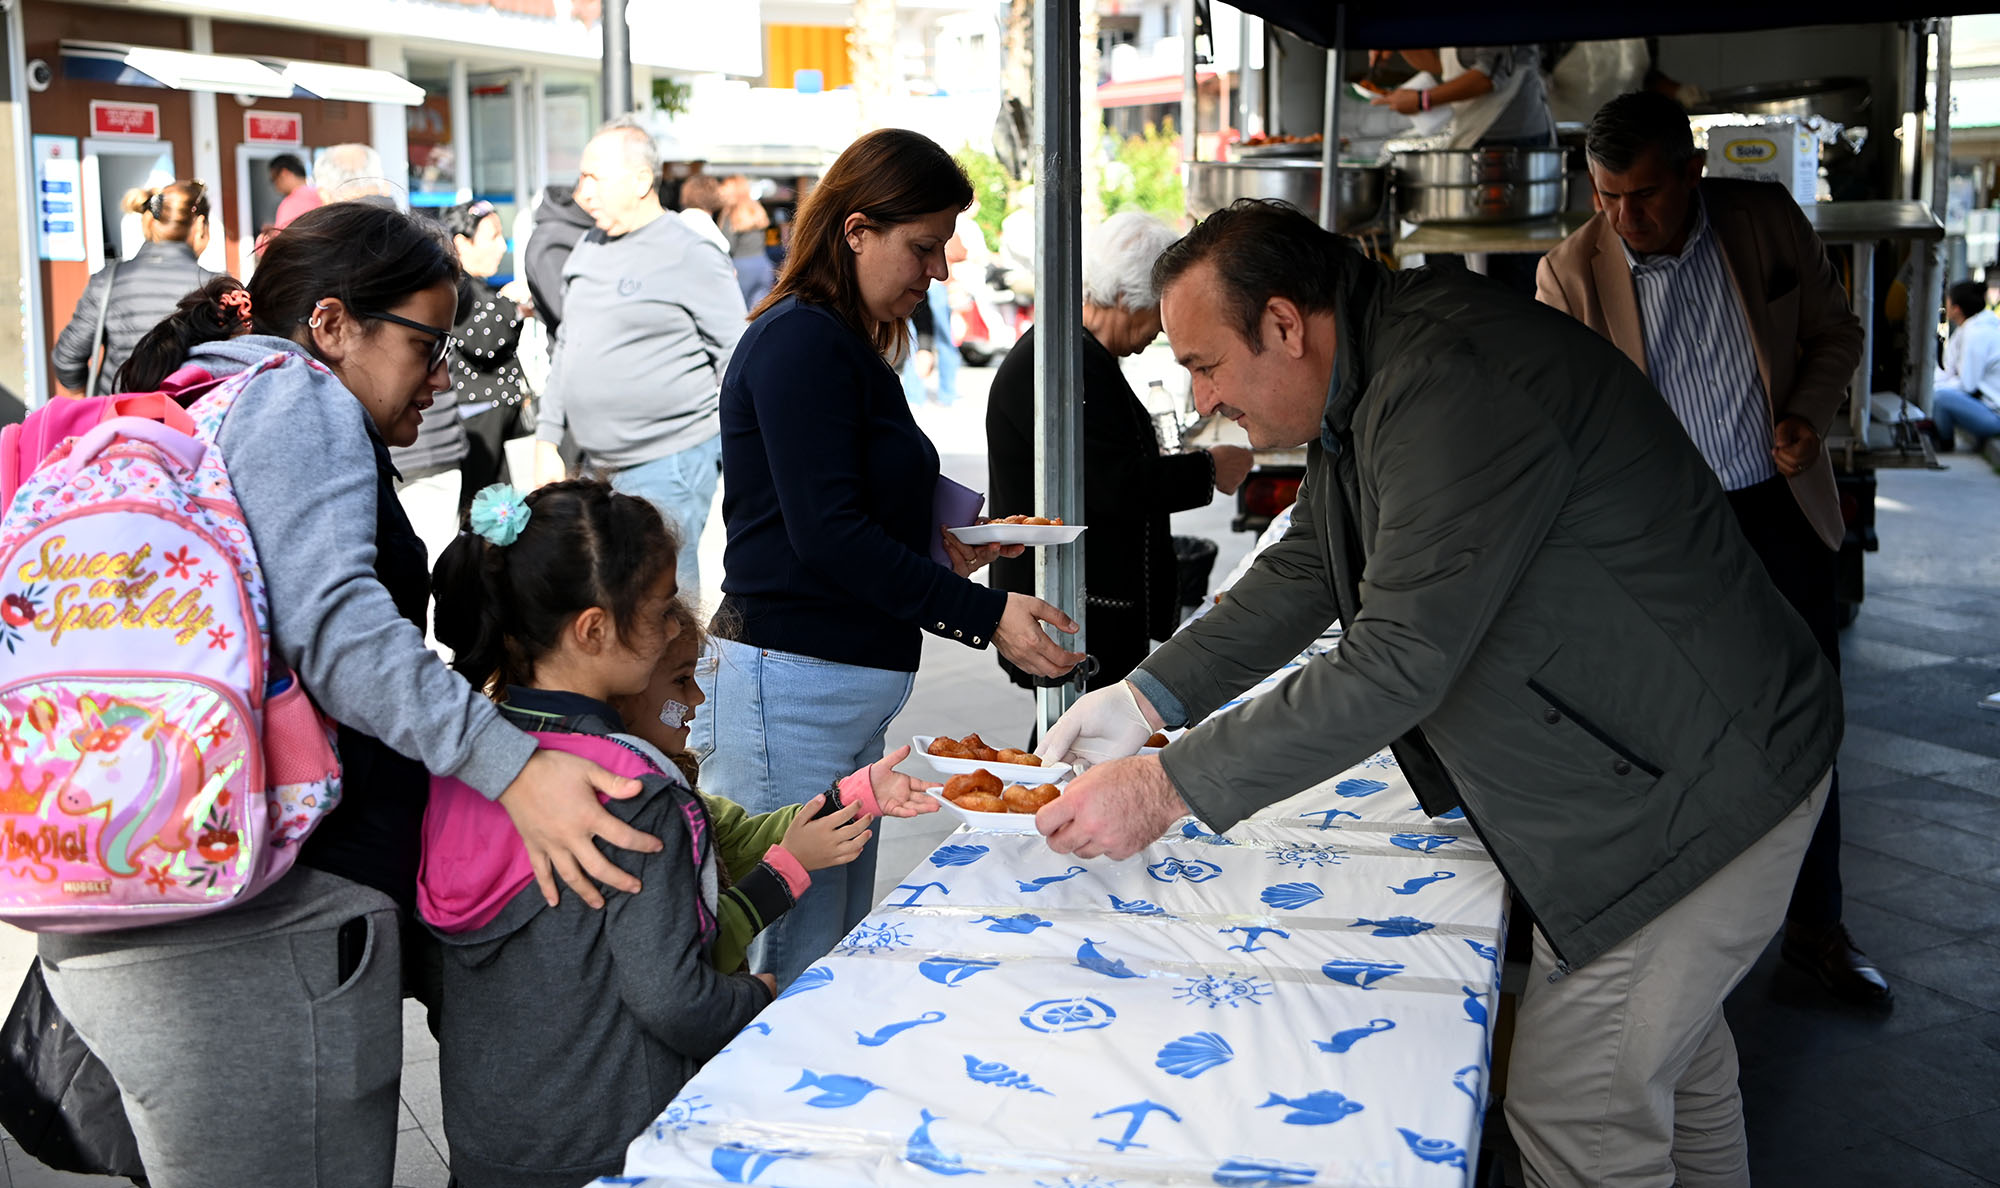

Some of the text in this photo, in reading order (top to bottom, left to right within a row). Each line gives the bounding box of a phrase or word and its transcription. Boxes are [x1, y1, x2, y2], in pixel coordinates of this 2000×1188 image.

[18, 535, 152, 583] Sweet
[88, 571, 158, 599] and
[33, 584, 214, 647] Sparkly
